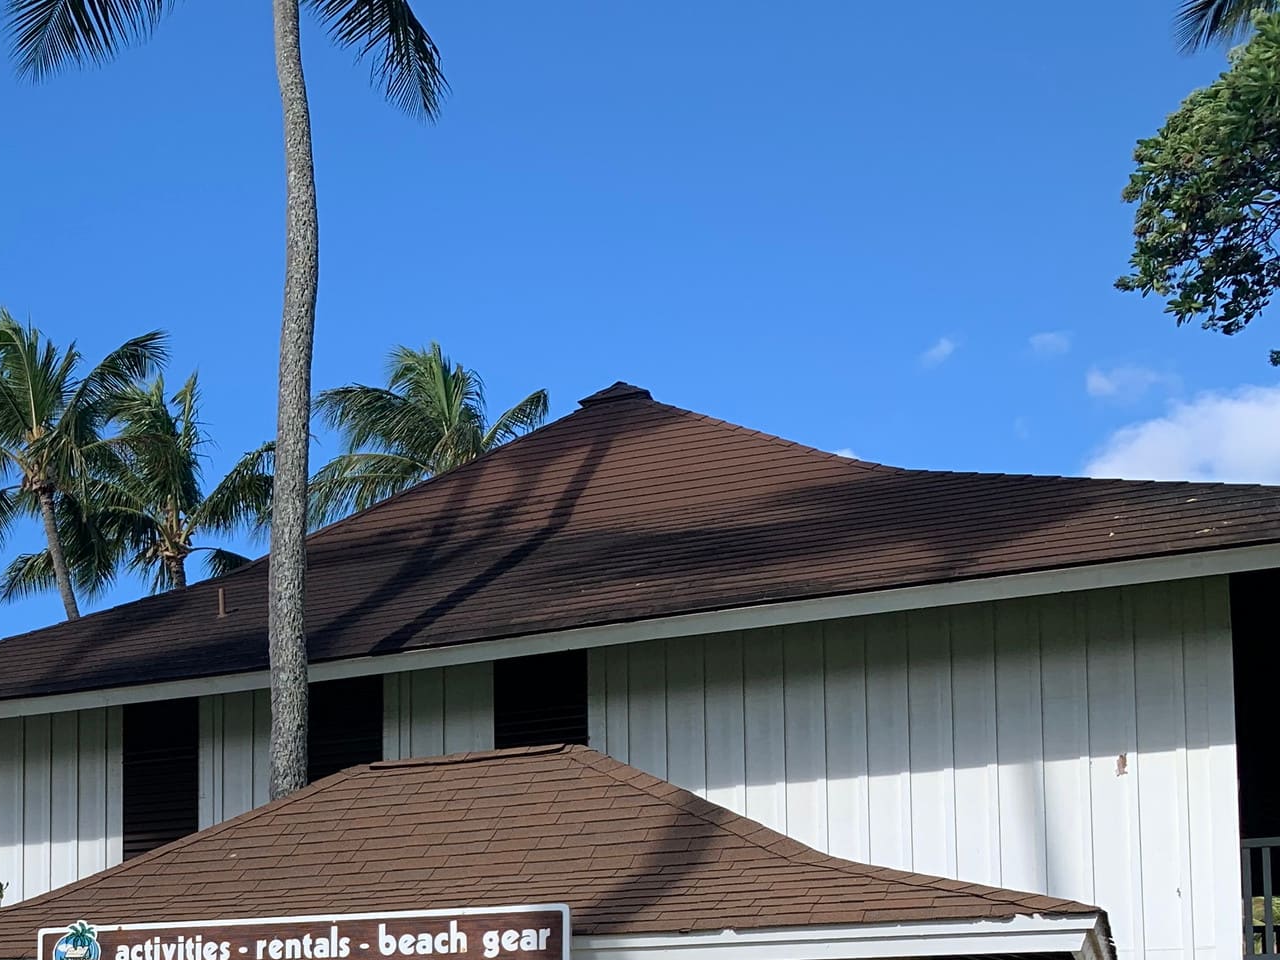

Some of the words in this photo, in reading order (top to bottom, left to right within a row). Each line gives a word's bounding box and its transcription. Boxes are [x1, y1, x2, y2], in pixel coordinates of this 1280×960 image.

[256, 925, 350, 960] rentals
[378, 921, 467, 956] beach
[483, 926, 550, 958] gear
